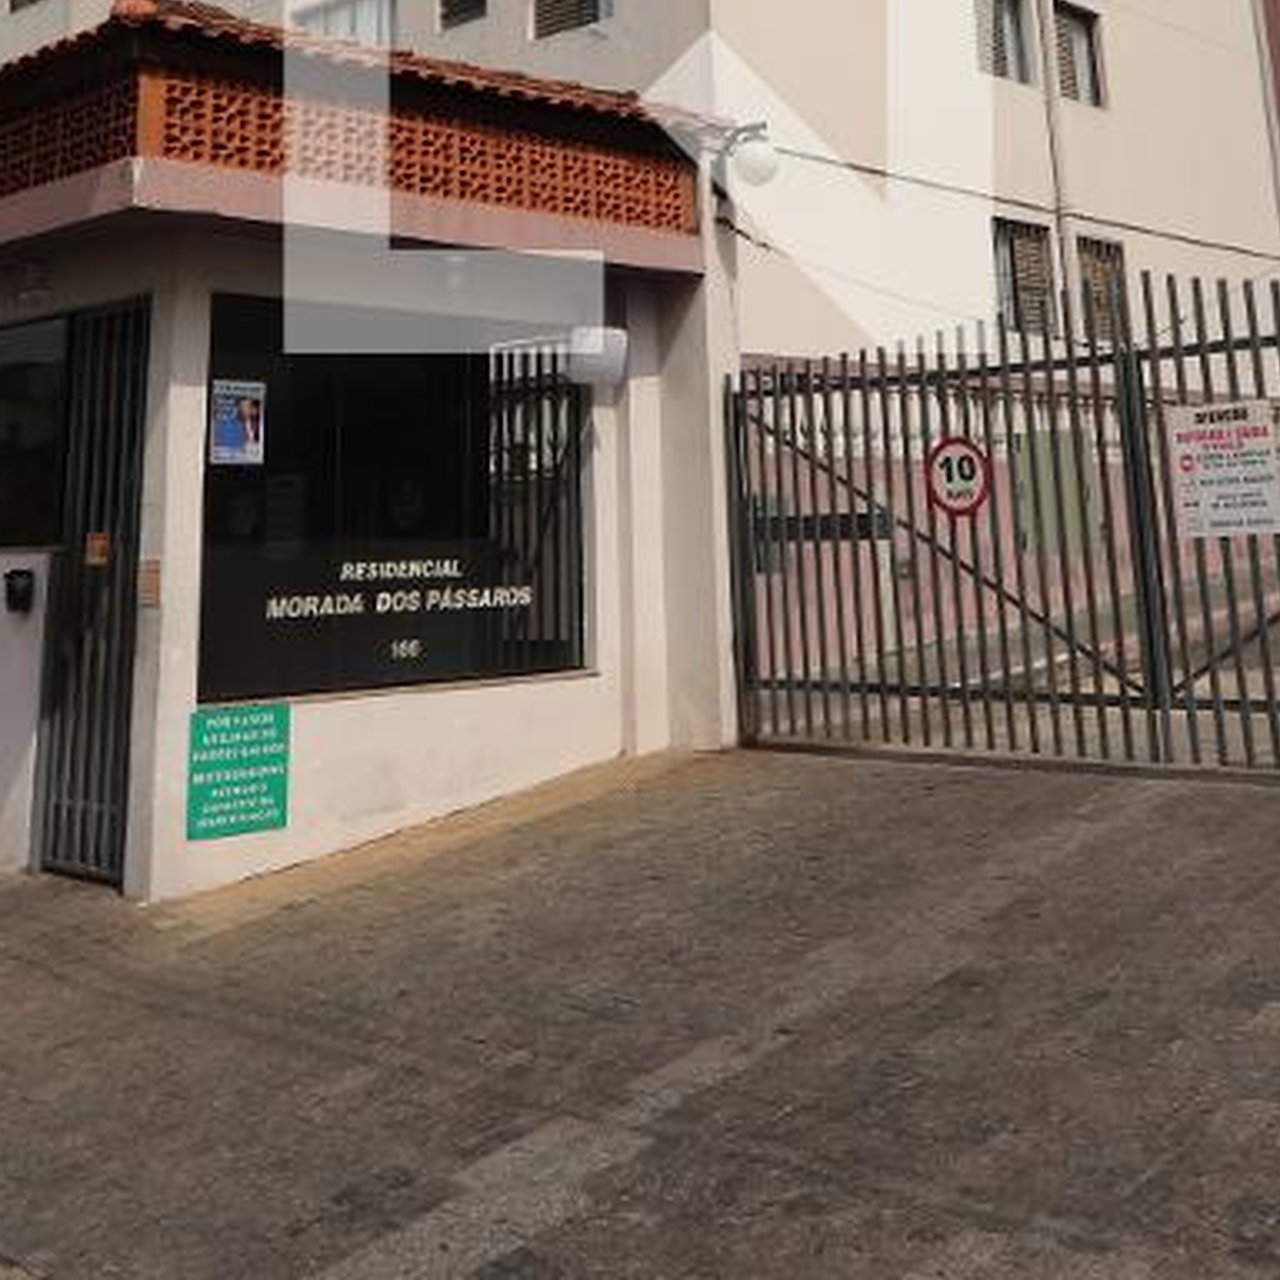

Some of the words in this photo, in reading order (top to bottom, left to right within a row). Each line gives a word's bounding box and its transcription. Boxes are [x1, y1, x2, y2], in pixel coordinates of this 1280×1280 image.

[939, 455, 976, 483] 10
[340, 560, 463, 581] RESIDENCIAL
[266, 593, 366, 618] MORADA
[375, 591, 421, 612] DOS
